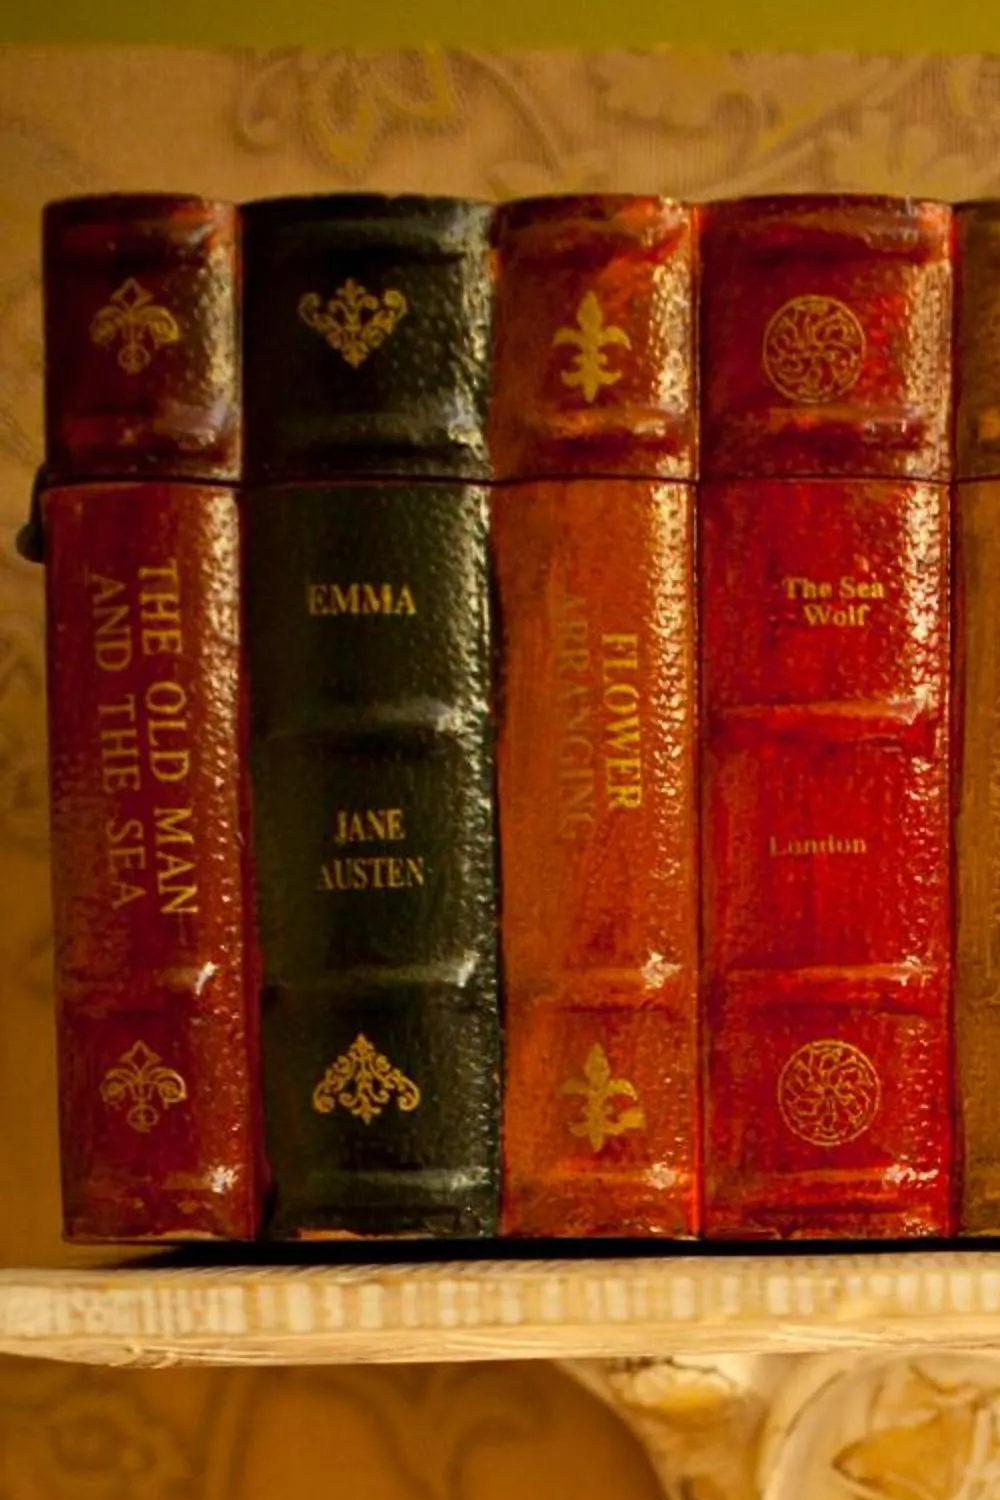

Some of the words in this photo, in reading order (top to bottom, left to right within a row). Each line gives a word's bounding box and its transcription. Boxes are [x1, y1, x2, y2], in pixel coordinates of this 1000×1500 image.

[89, 573, 131, 672] AND
[138, 559, 183, 657] THE
[308, 583, 417, 616] EMMA
[784, 576, 832, 600] The
[839, 575, 886, 600] Sea
[803, 604, 869, 628] Wolf
[97, 694, 141, 794] THE
[144, 681, 191, 783] OLD
[601, 632, 643, 810] FLOWER
[104, 816, 148, 912] SEA
[153, 807, 199, 915] MAN
[316, 856, 425, 890] AUSTEN
[335, 808, 406, 844] JANE
